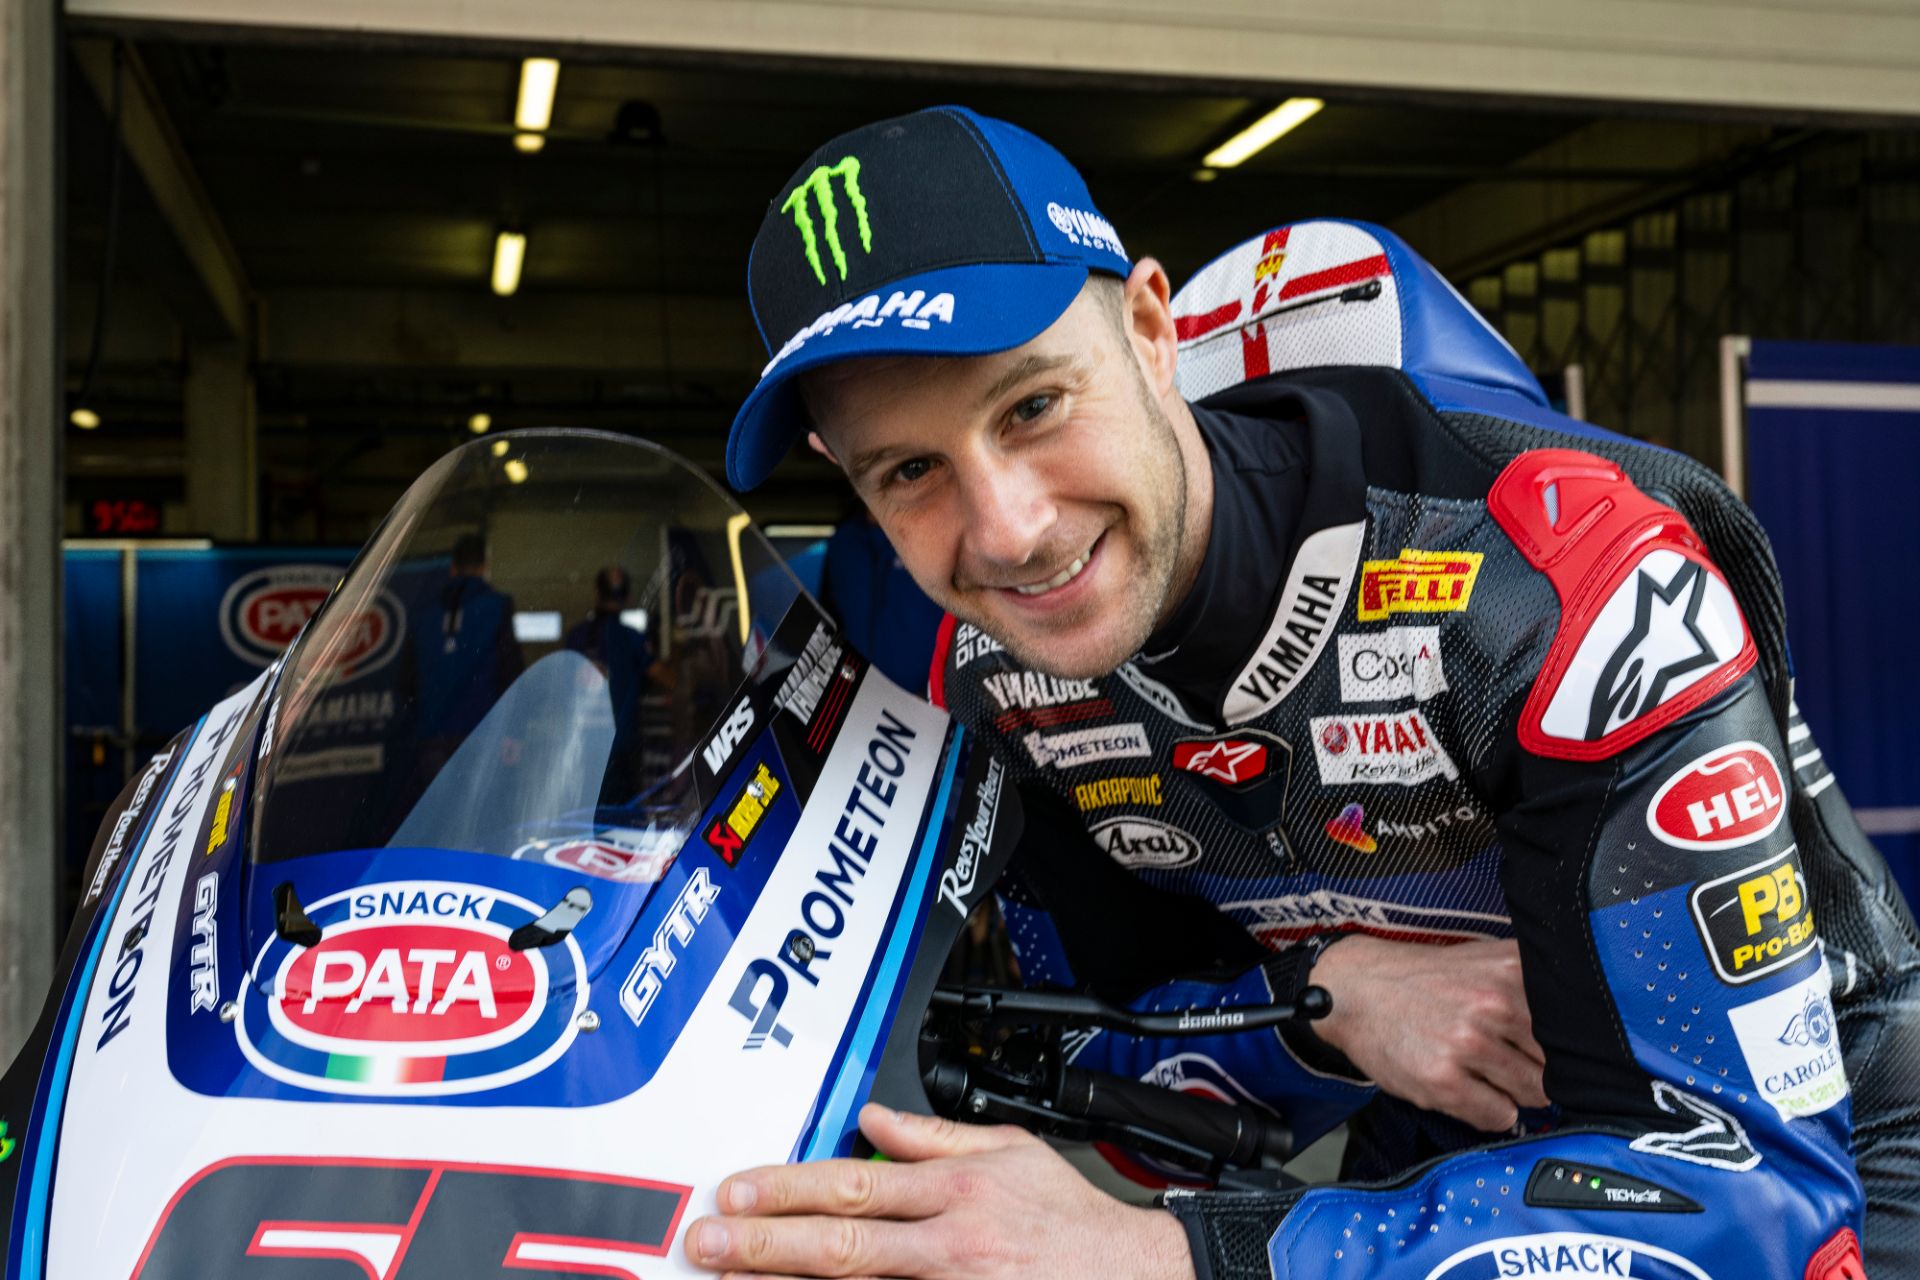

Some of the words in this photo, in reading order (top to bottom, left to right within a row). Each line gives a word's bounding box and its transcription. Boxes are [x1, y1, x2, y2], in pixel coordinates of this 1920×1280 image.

[1238, 574, 1341, 704] YAMAHA
[702, 695, 755, 776] WRS
[1687, 773, 1780, 838] HEL
[1107, 828, 1185, 857] Arai
[354, 891, 487, 919] SNACK
[727, 709, 917, 1050] PROMETEON
[1738, 862, 1802, 937] PB
[190, 871, 221, 1017] GYTR
[617, 866, 722, 1027] GYTR
[301, 948, 497, 1019] PATA
[1178, 1006, 1244, 1029] domino
[1500, 1245, 1626, 1278] SNACK
